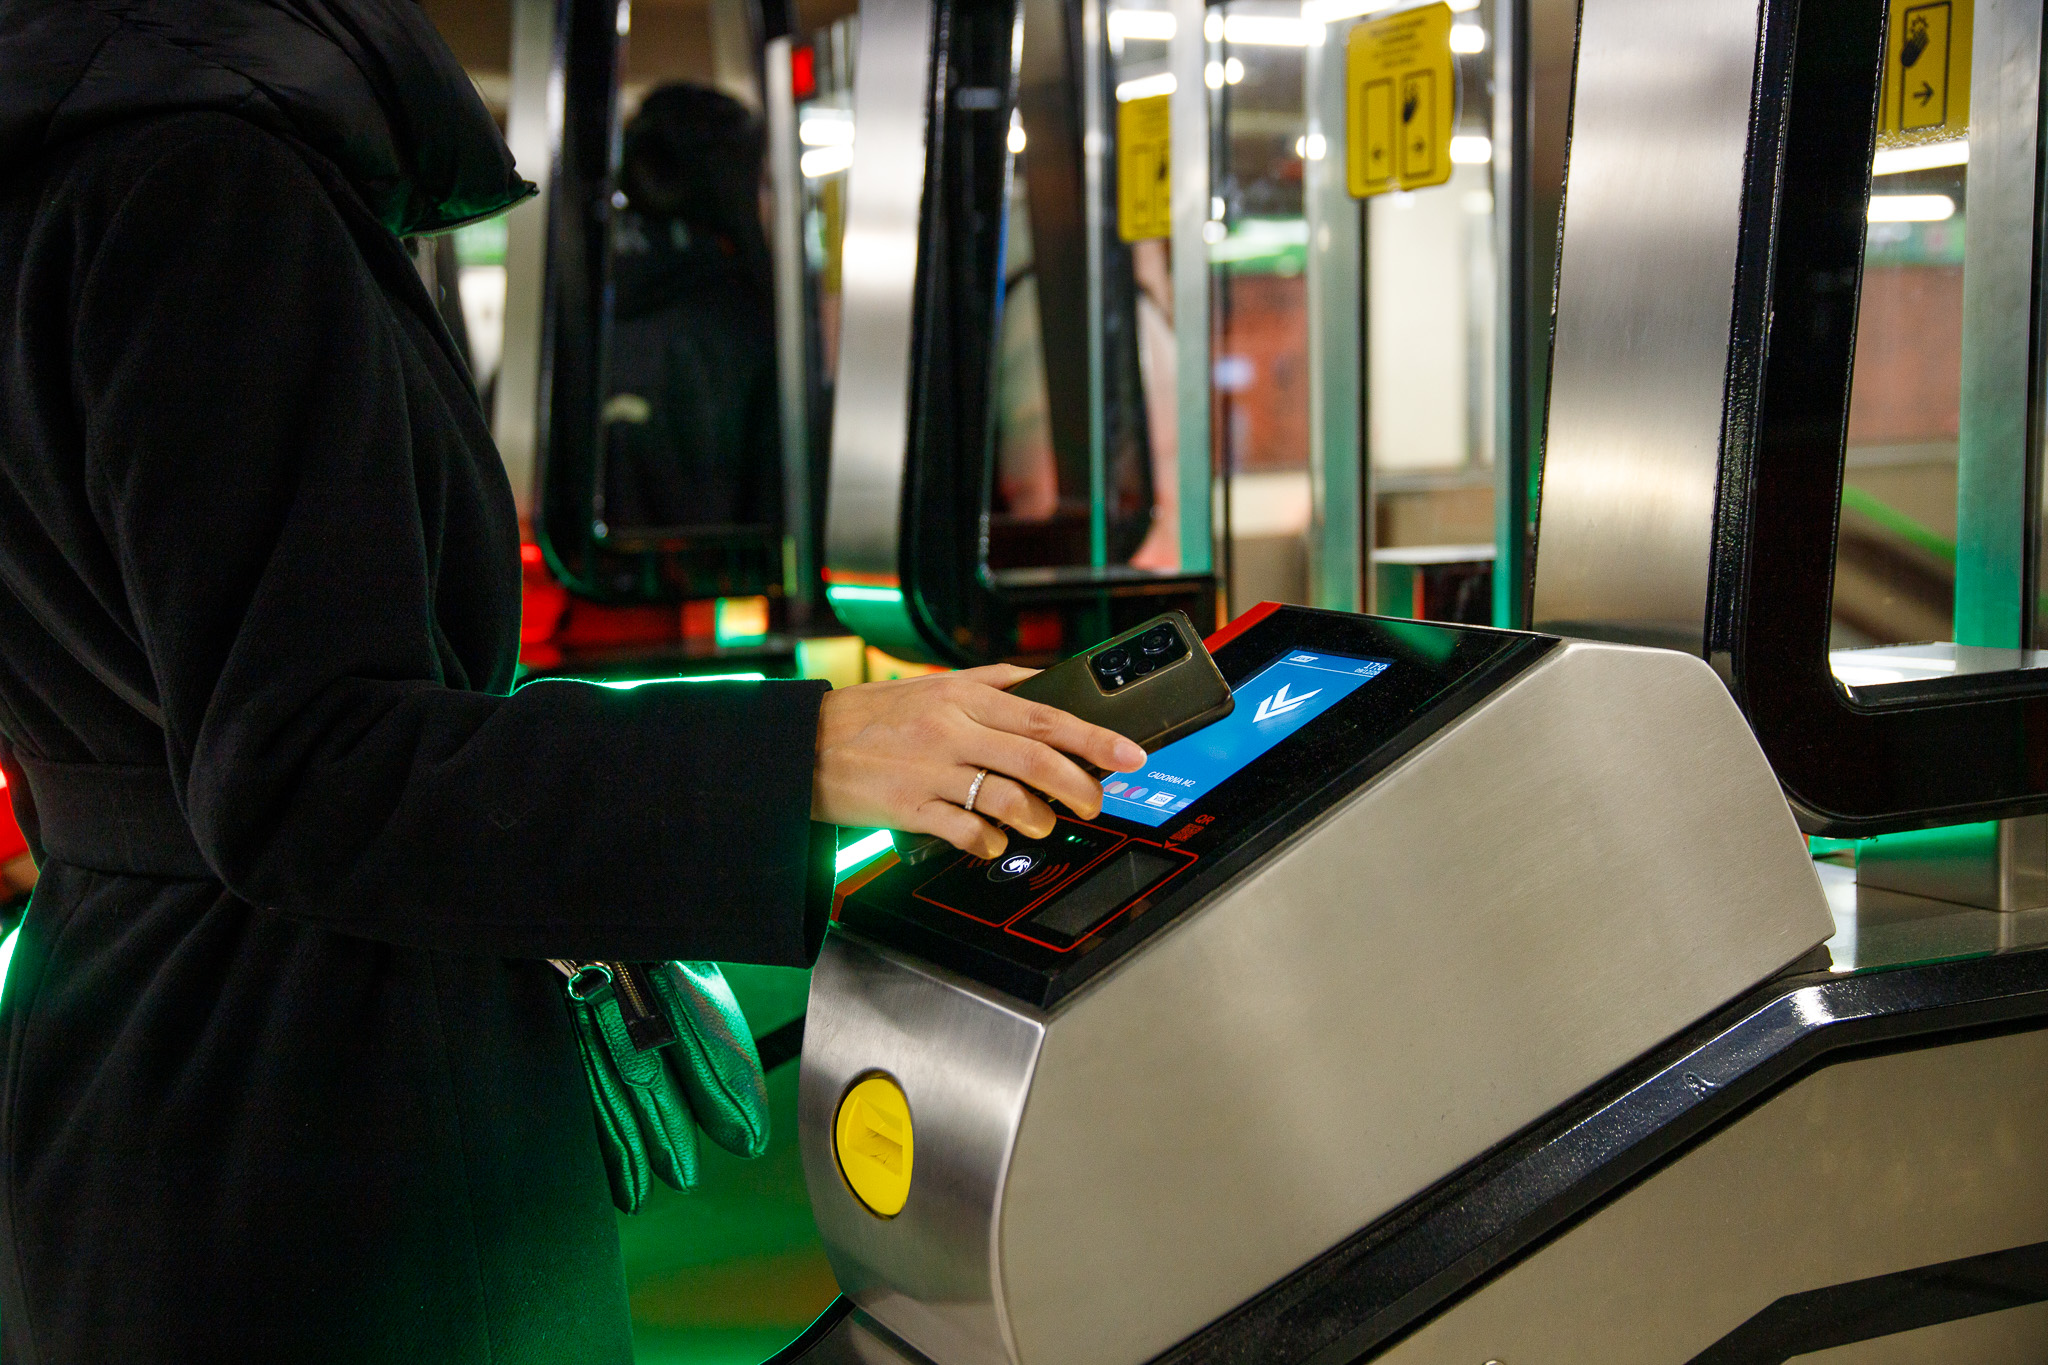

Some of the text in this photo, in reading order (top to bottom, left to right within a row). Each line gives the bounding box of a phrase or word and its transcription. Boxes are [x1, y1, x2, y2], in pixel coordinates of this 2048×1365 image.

[1147, 771, 1196, 788] CADORNA M2
[1195, 814, 1215, 825] QR
